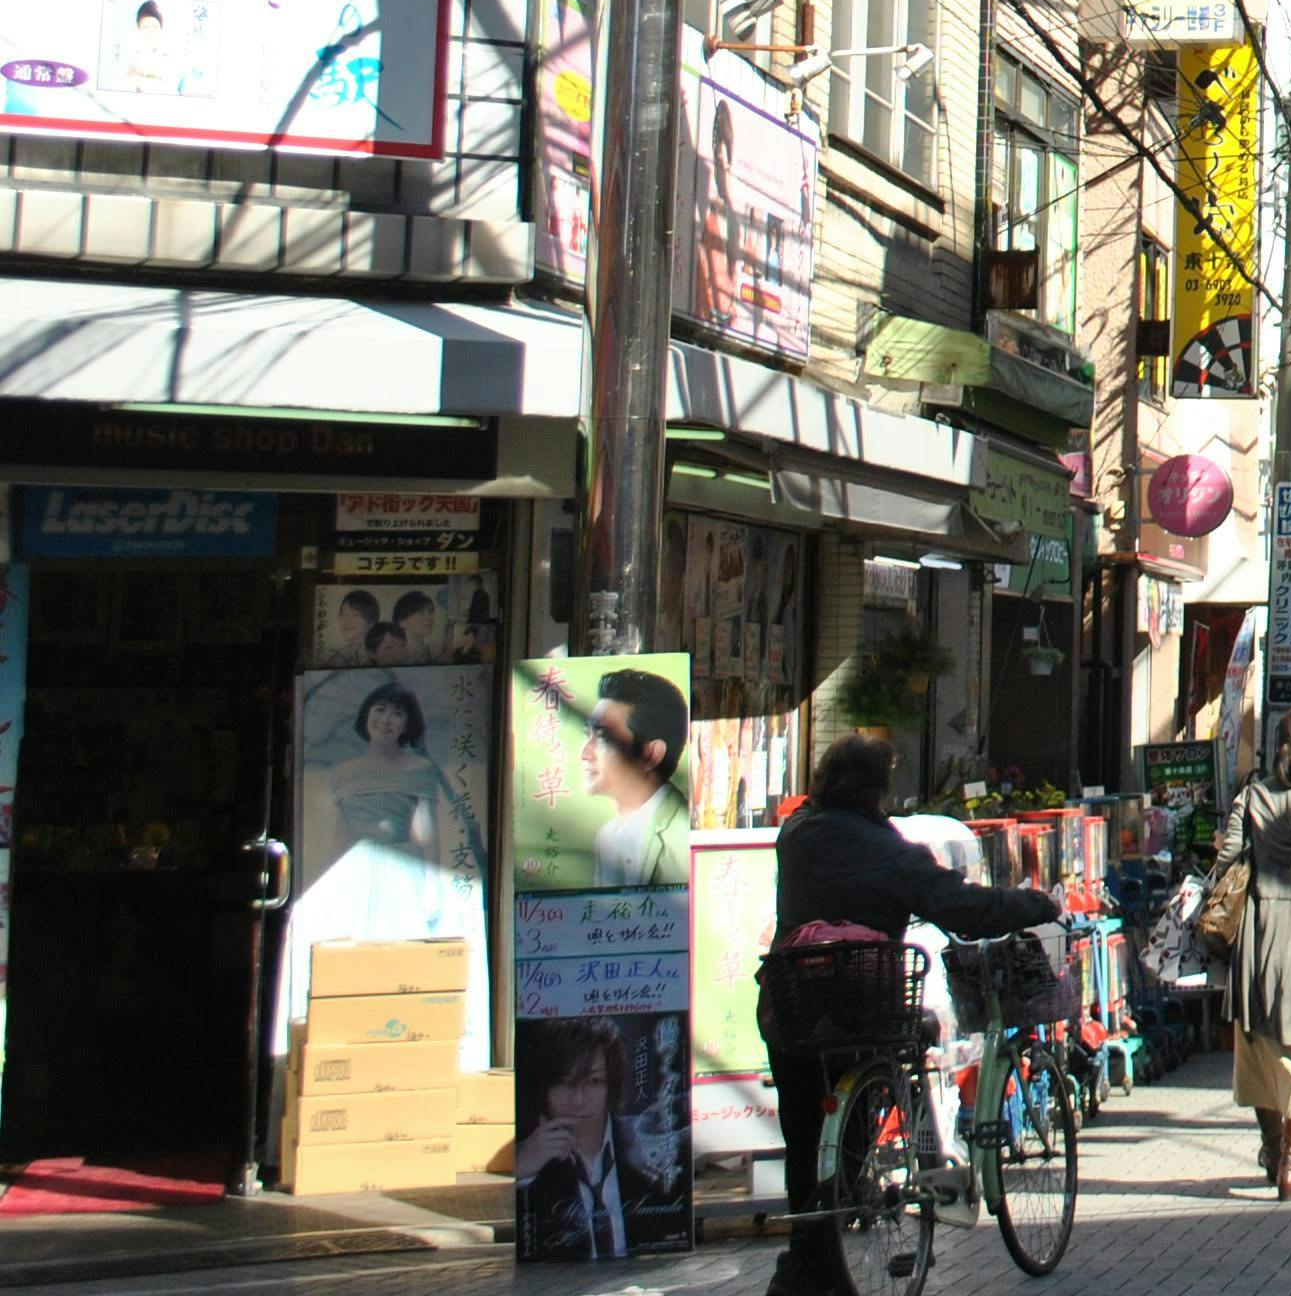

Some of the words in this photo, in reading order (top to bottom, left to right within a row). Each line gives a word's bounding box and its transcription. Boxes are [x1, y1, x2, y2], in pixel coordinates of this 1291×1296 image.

[213, 425, 299, 456] shop
[311, 427, 375, 456] Dan
[1274, 585, 1290, 644] クリニック
